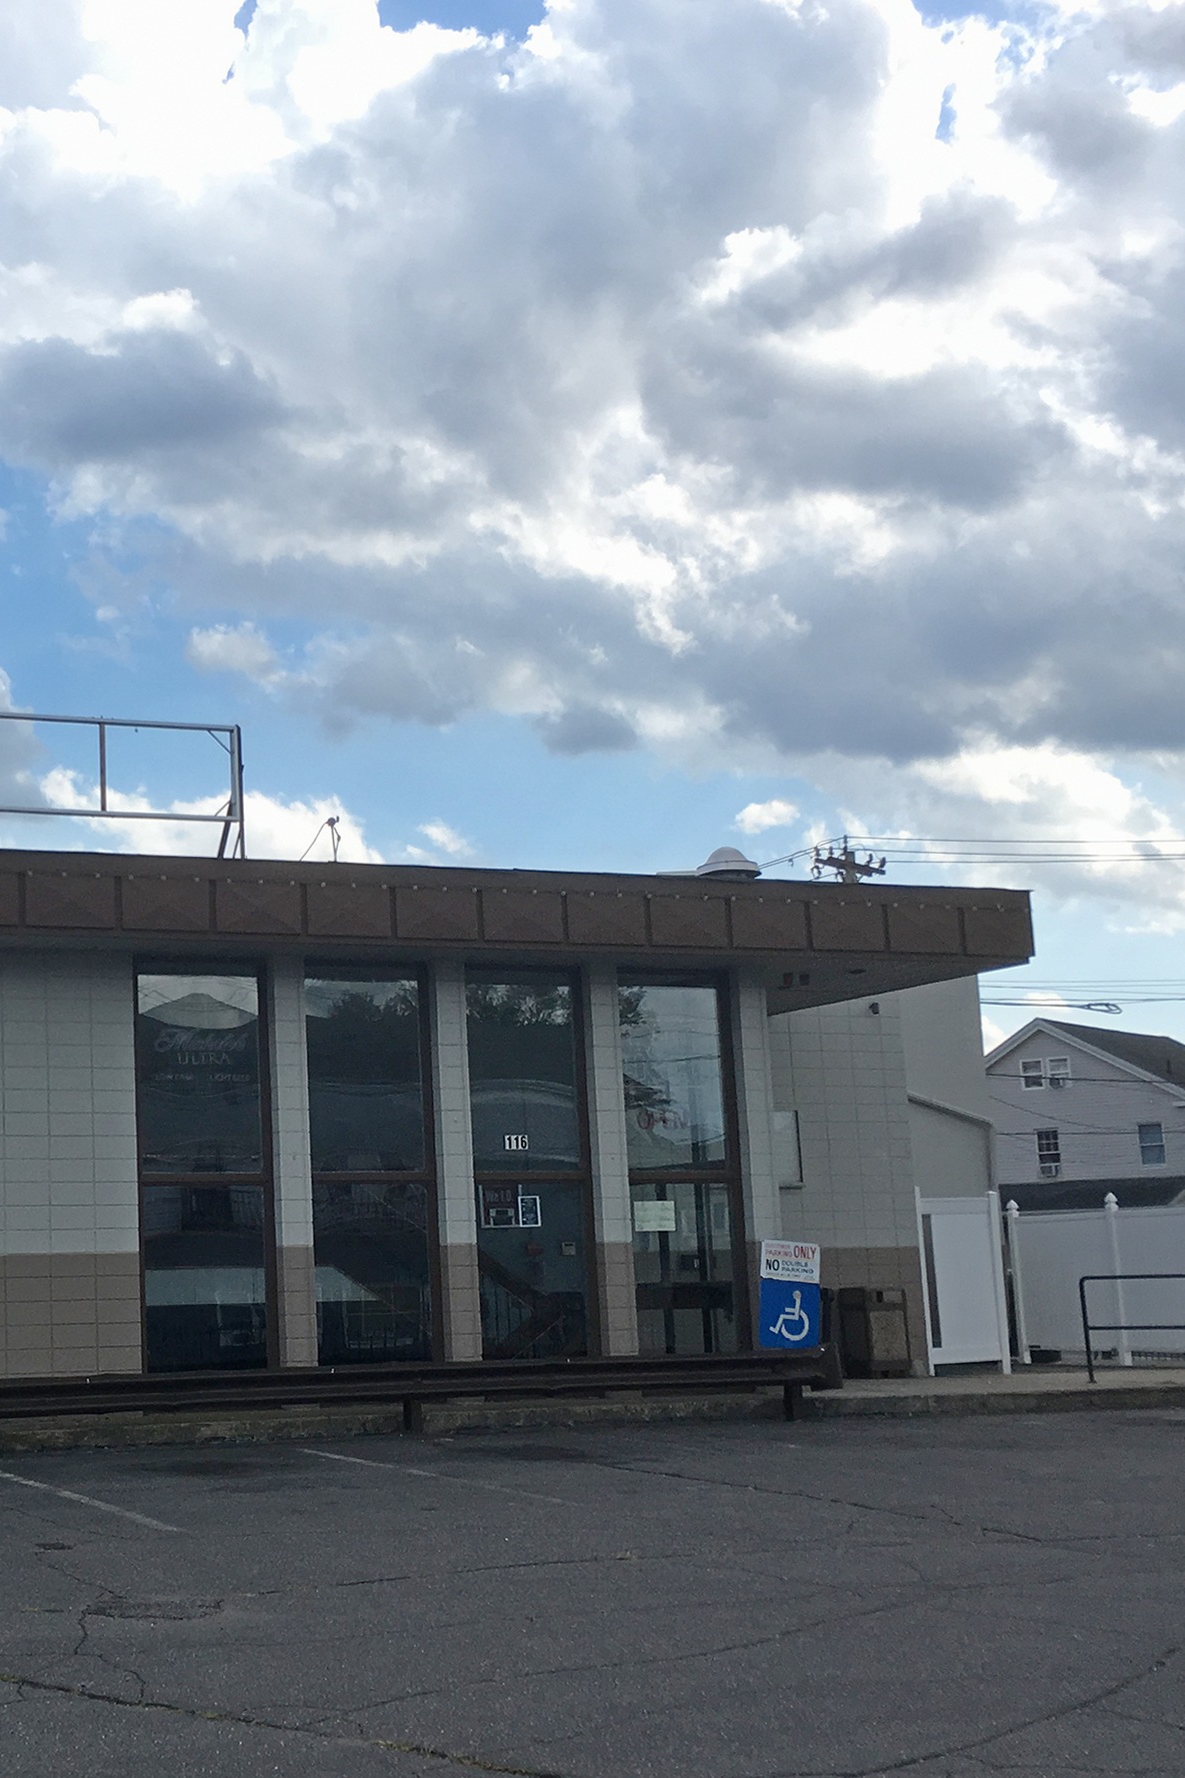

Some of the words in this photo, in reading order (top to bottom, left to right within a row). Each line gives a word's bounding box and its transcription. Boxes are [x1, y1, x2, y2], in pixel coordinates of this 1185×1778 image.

[177, 1052, 231, 1065] ULTRA
[506, 1135, 527, 1149] 116
[793, 1245, 817, 1259] ONLY
[765, 1258, 780, 1271] NO
